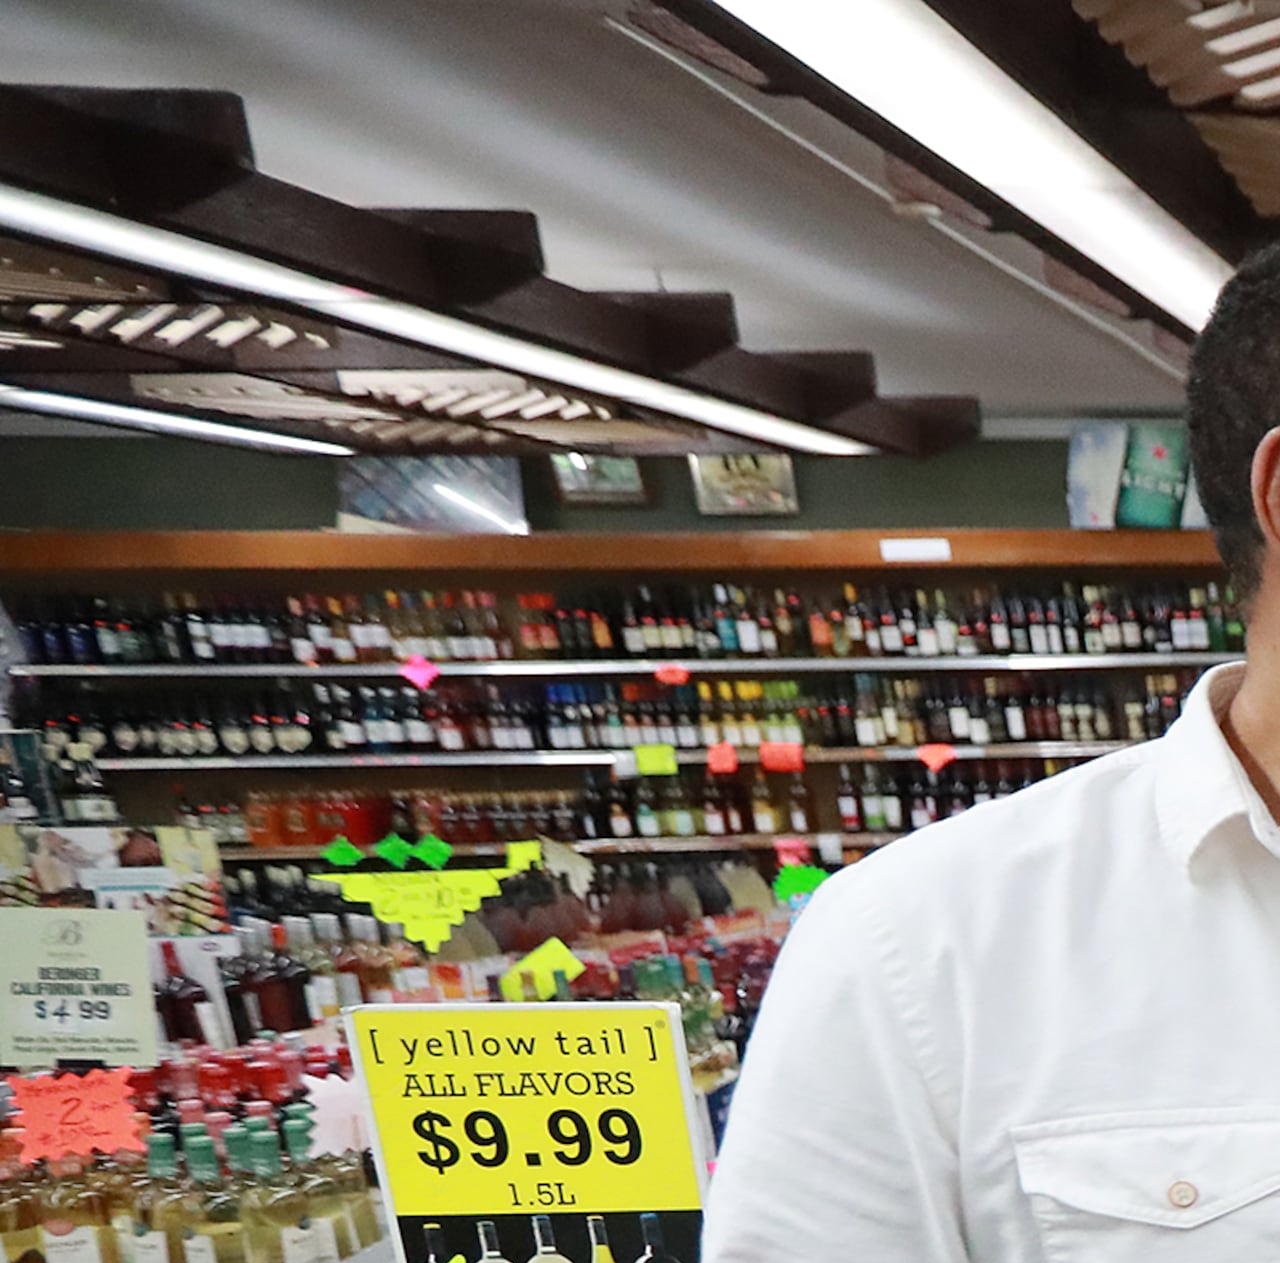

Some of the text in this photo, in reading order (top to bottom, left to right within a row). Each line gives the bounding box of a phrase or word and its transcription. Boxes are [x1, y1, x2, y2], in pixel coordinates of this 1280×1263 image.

[38, 966, 101, 981] BERINGER
[11, 981, 132, 997] CALIFORNIA WINES
[79, 1001, 110, 1019] 99
[401, 1030, 536, 1065] yellow
[555, 1028, 626, 1055] tail
[402, 1072, 635, 1098] ALL FLAVORS
[412, 1109, 643, 1175] $9.99
[508, 1182, 576, 1206] 1.5L
